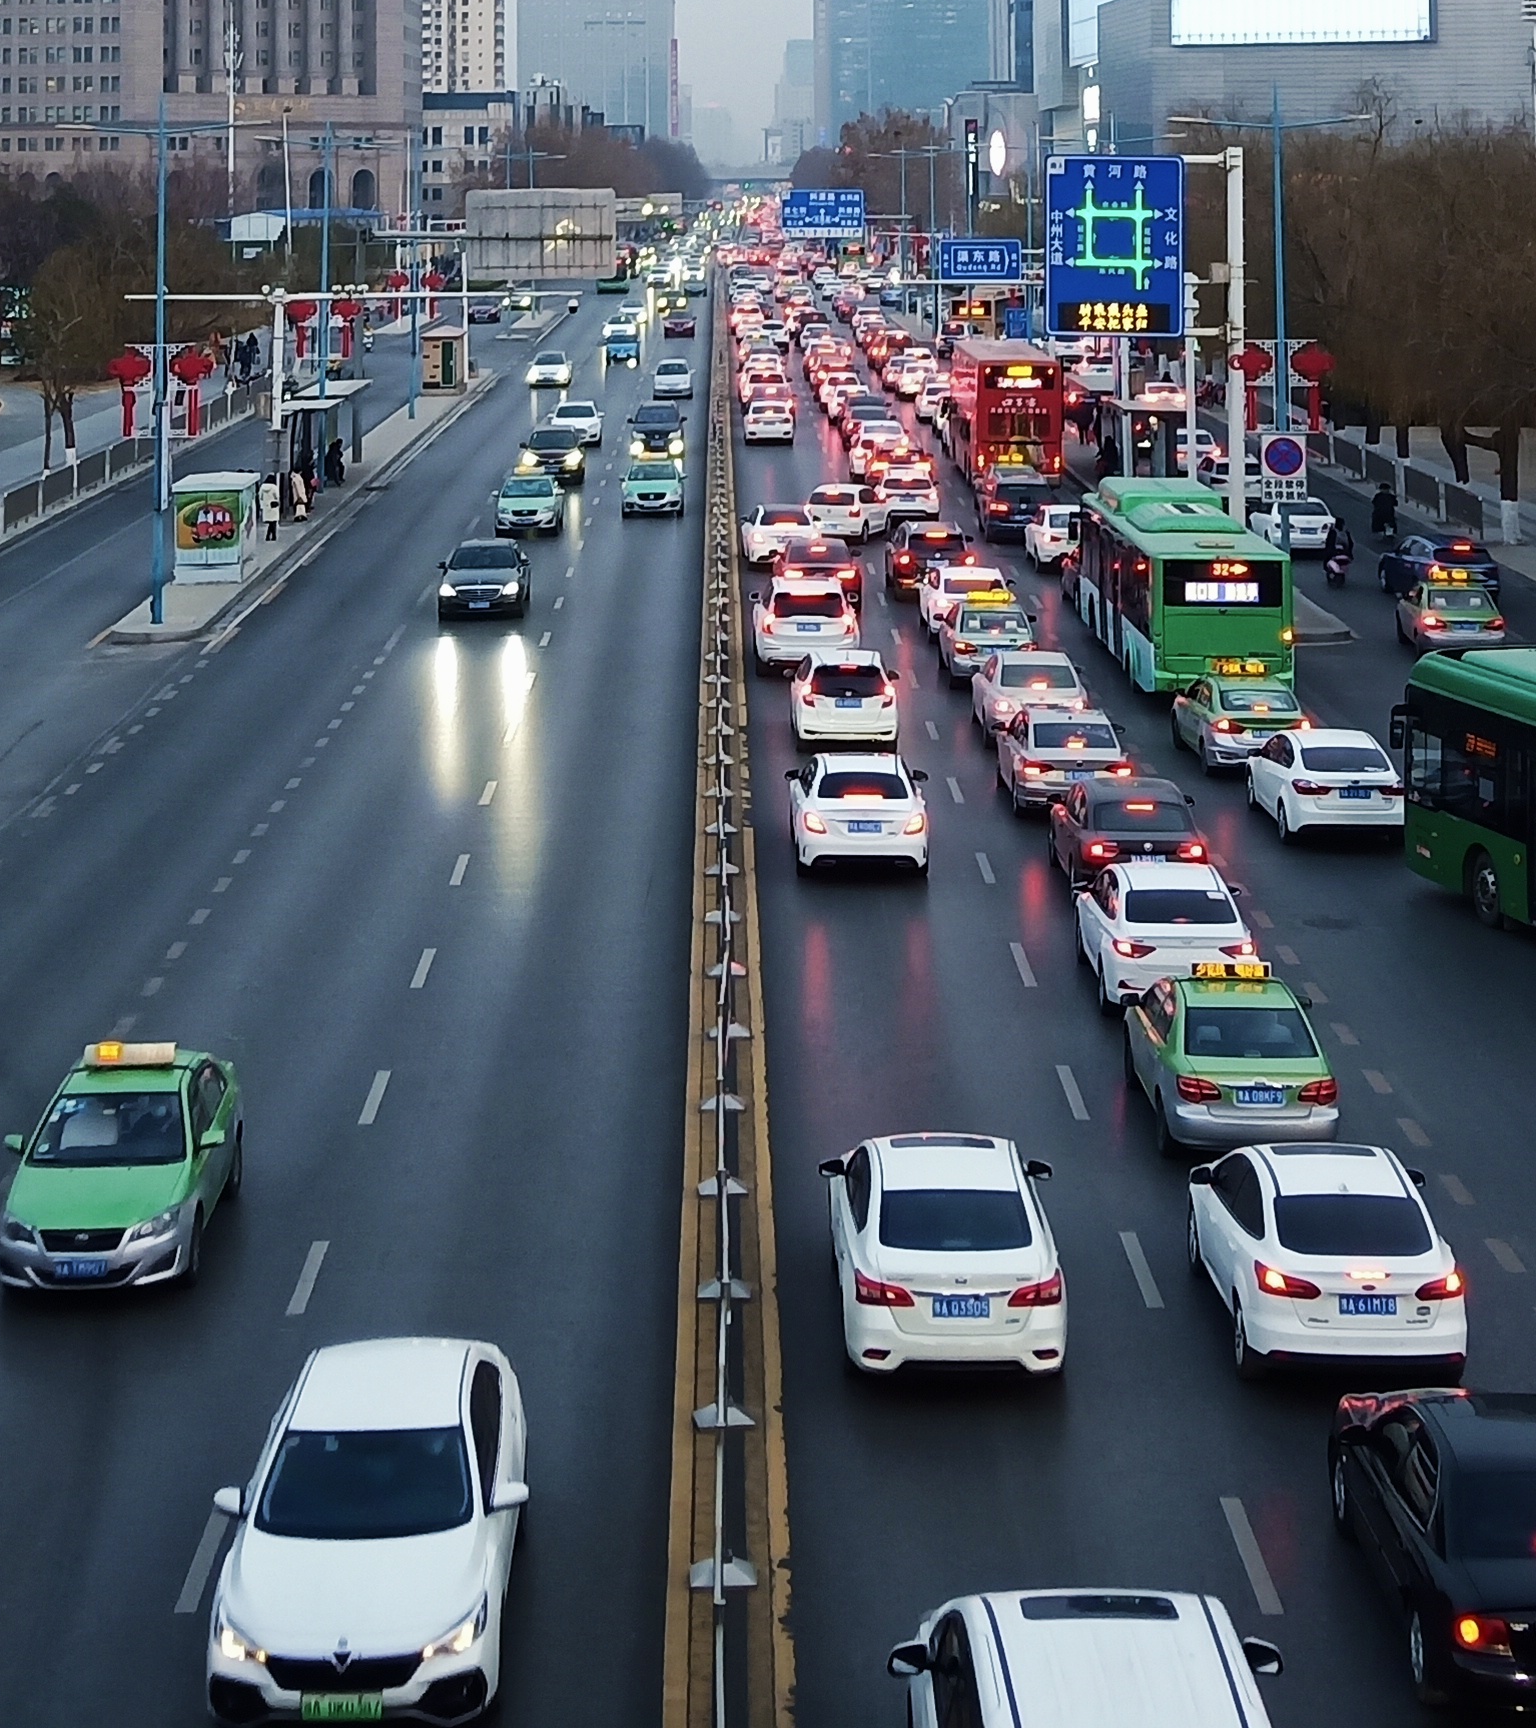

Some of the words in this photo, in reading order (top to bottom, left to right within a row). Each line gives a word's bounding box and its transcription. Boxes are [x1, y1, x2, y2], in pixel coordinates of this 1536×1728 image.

[1082, 164, 1147, 179] 黄河路
[1050, 210, 1064, 266] 中州大道
[1164, 207, 1178, 270] 文化路
[1264, 479, 1305, 490] 全段禁停
[1213, 564, 1229, 575] 32
